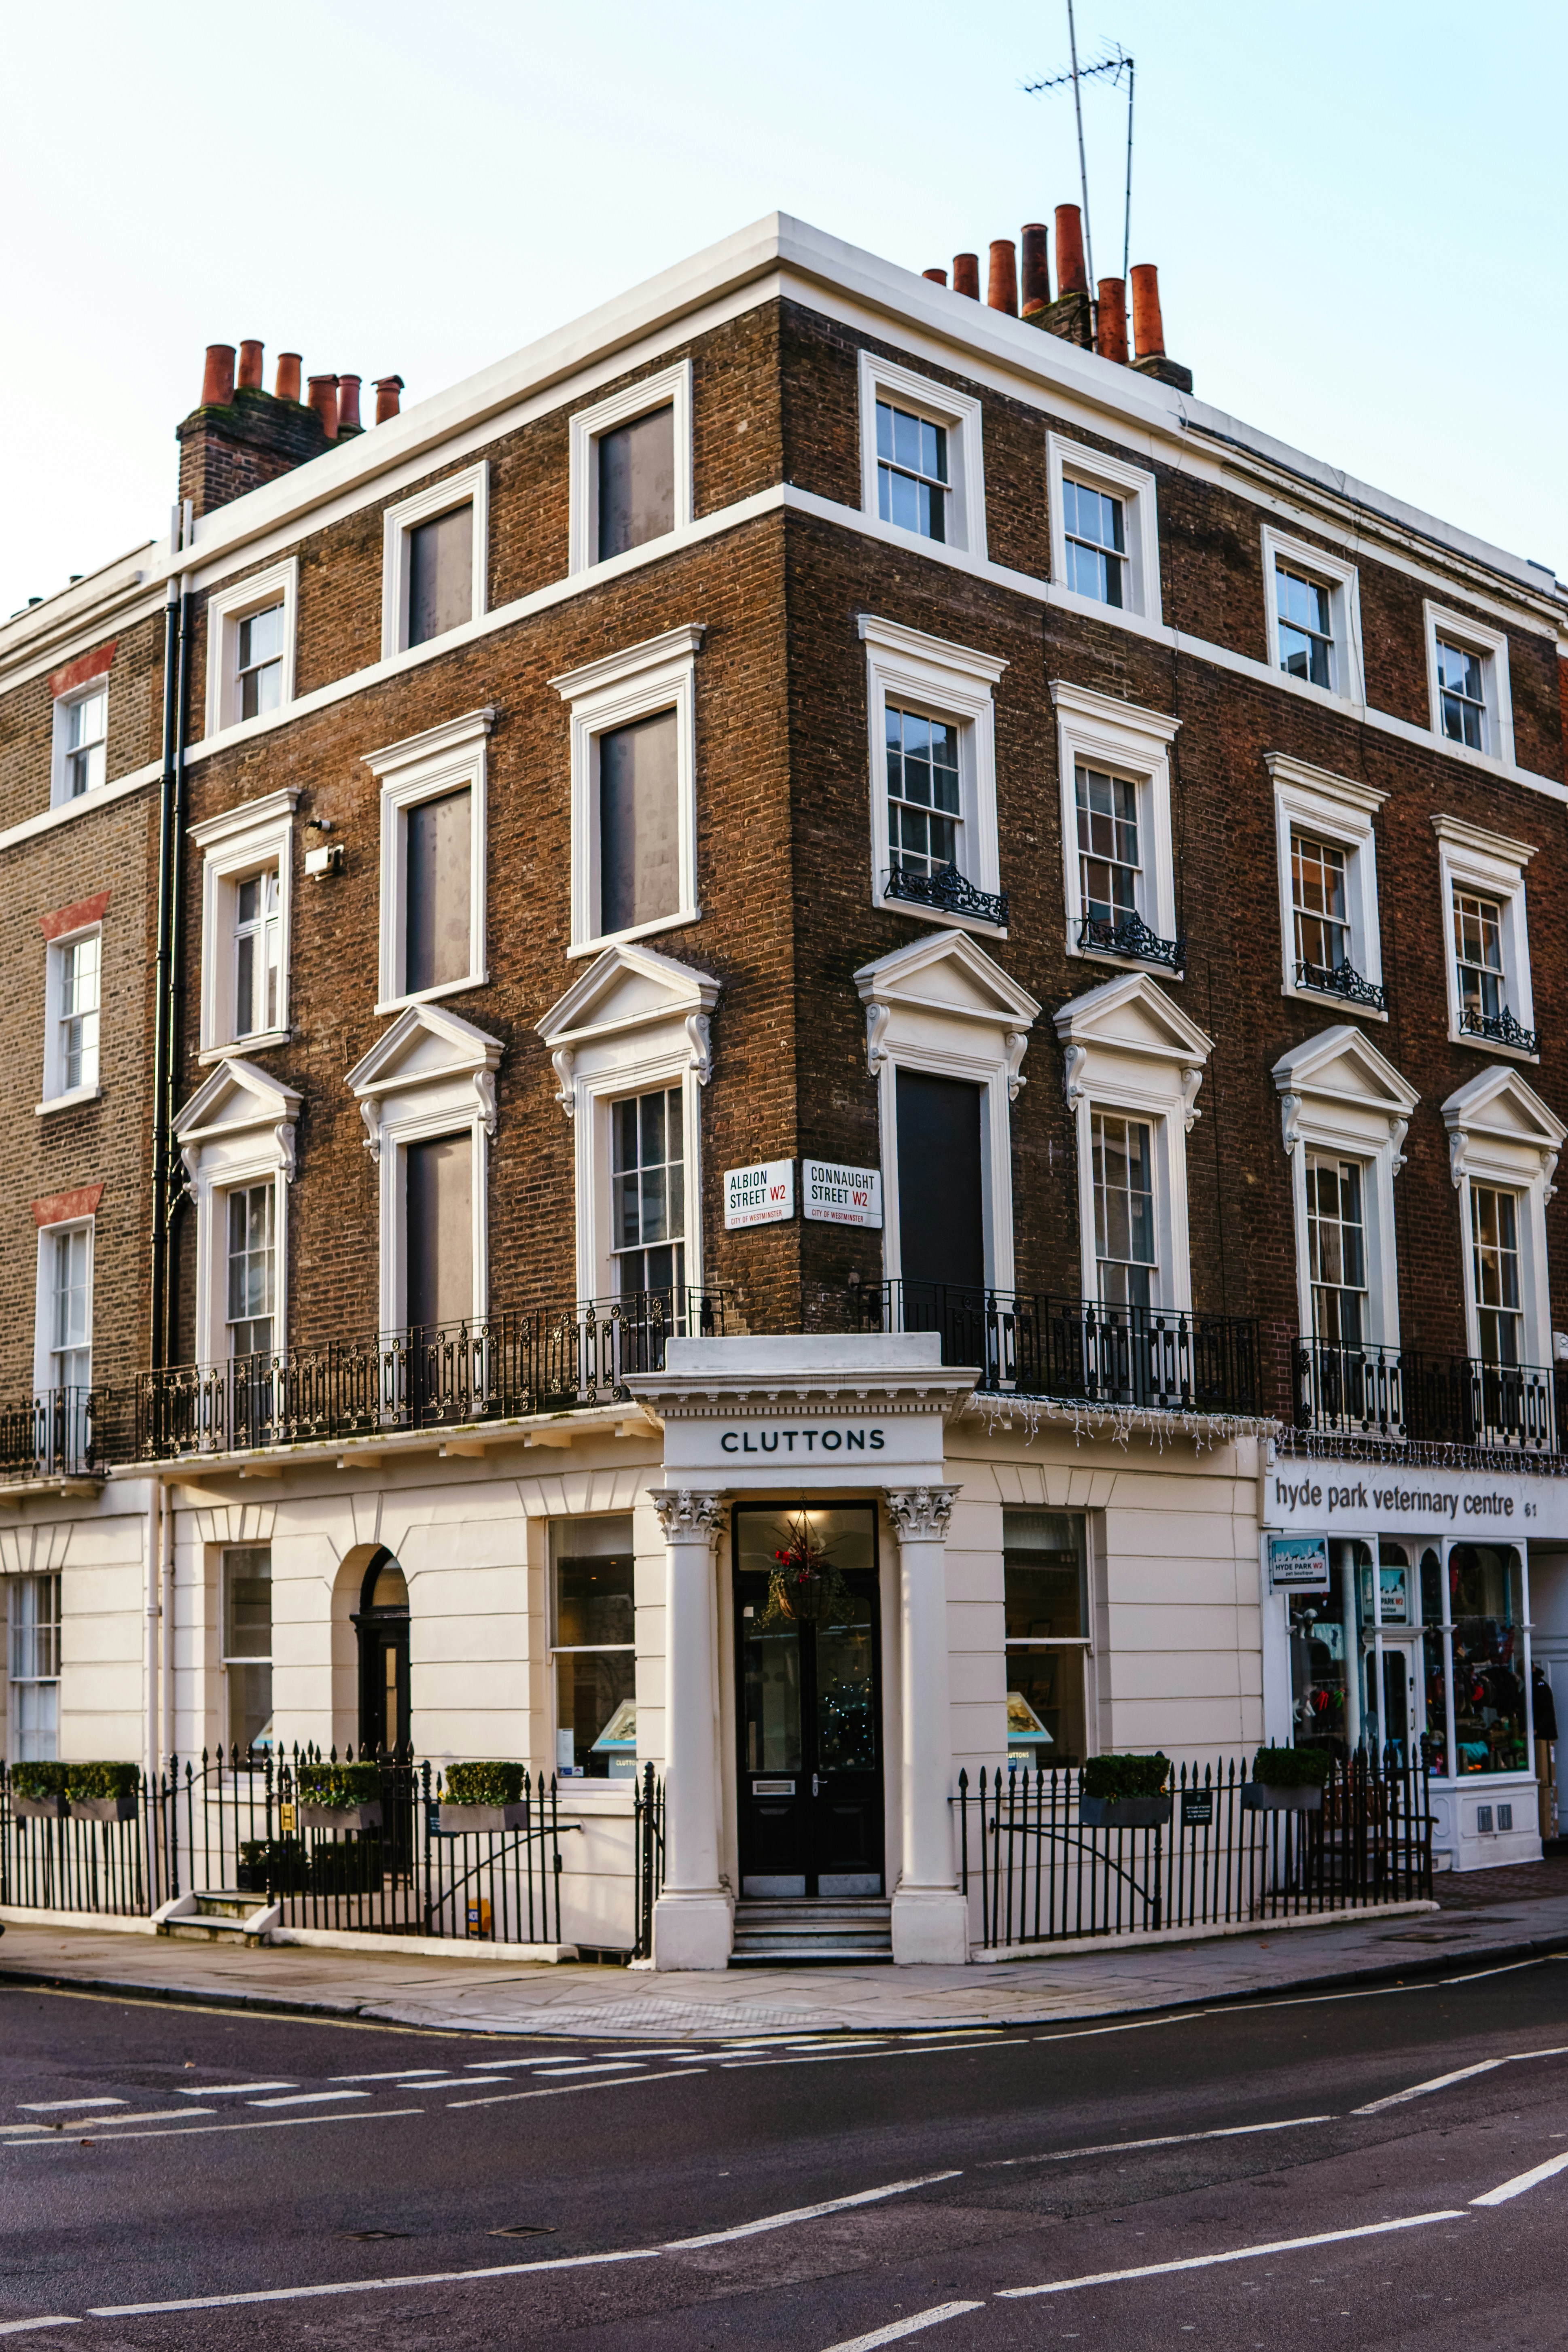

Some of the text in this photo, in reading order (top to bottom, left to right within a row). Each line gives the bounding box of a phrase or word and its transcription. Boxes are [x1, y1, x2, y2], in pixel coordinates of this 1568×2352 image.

[731, 1170, 767, 1191] ALBION
[811, 1166, 874, 1190] CONNAUGHT
[730, 1184, 786, 1209] STREET W2
[812, 1184, 867, 1207] STREET W2
[749, 1210, 782, 1221] WESTMINSTER
[831, 1212, 863, 1223] WESTMINSTER
[721, 1430, 885, 1452] CLUTTONS
[1276, 1477, 1514, 1519] hyde park veterinary centre
[1525, 1503, 1537, 1517] 61
